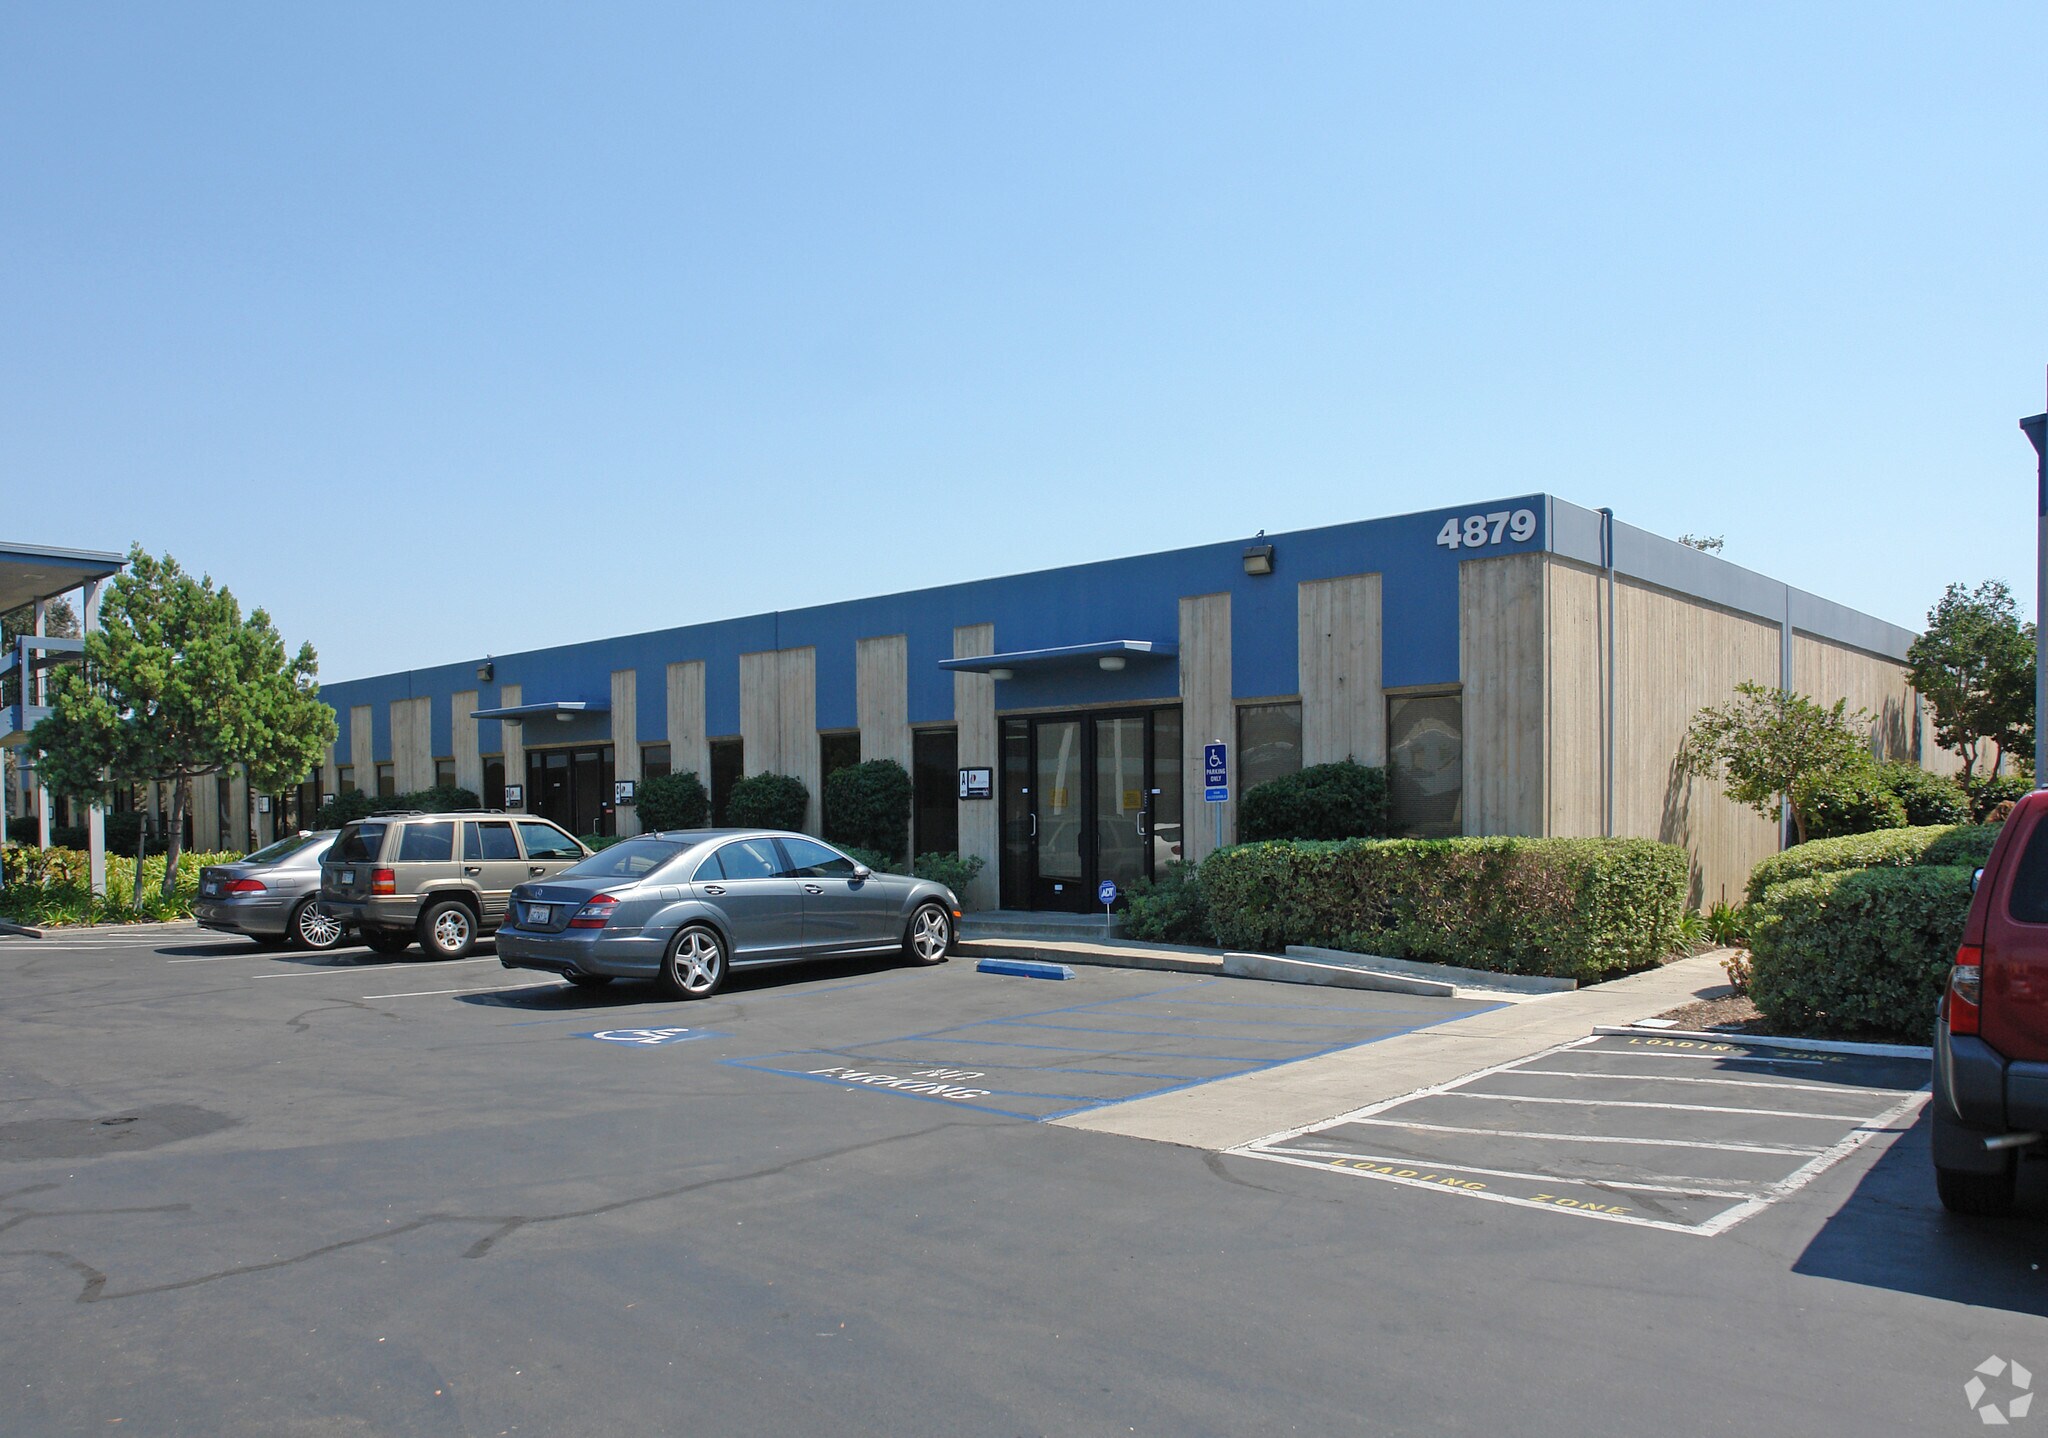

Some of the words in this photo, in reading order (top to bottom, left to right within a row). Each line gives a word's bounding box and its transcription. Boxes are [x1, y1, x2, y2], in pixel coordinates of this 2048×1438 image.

[1436, 509, 1537, 549] 4879
[961, 772, 966, 786] A
[1101, 887, 1114, 898] ADT
[1628, 1037, 1746, 1052] LOADING
[1775, 1051, 1848, 1063] ZONE
[807, 1066, 992, 1099] PARKING
[1329, 1158, 1488, 1191] LOADING
[1528, 1193, 1633, 1216] ZONE
